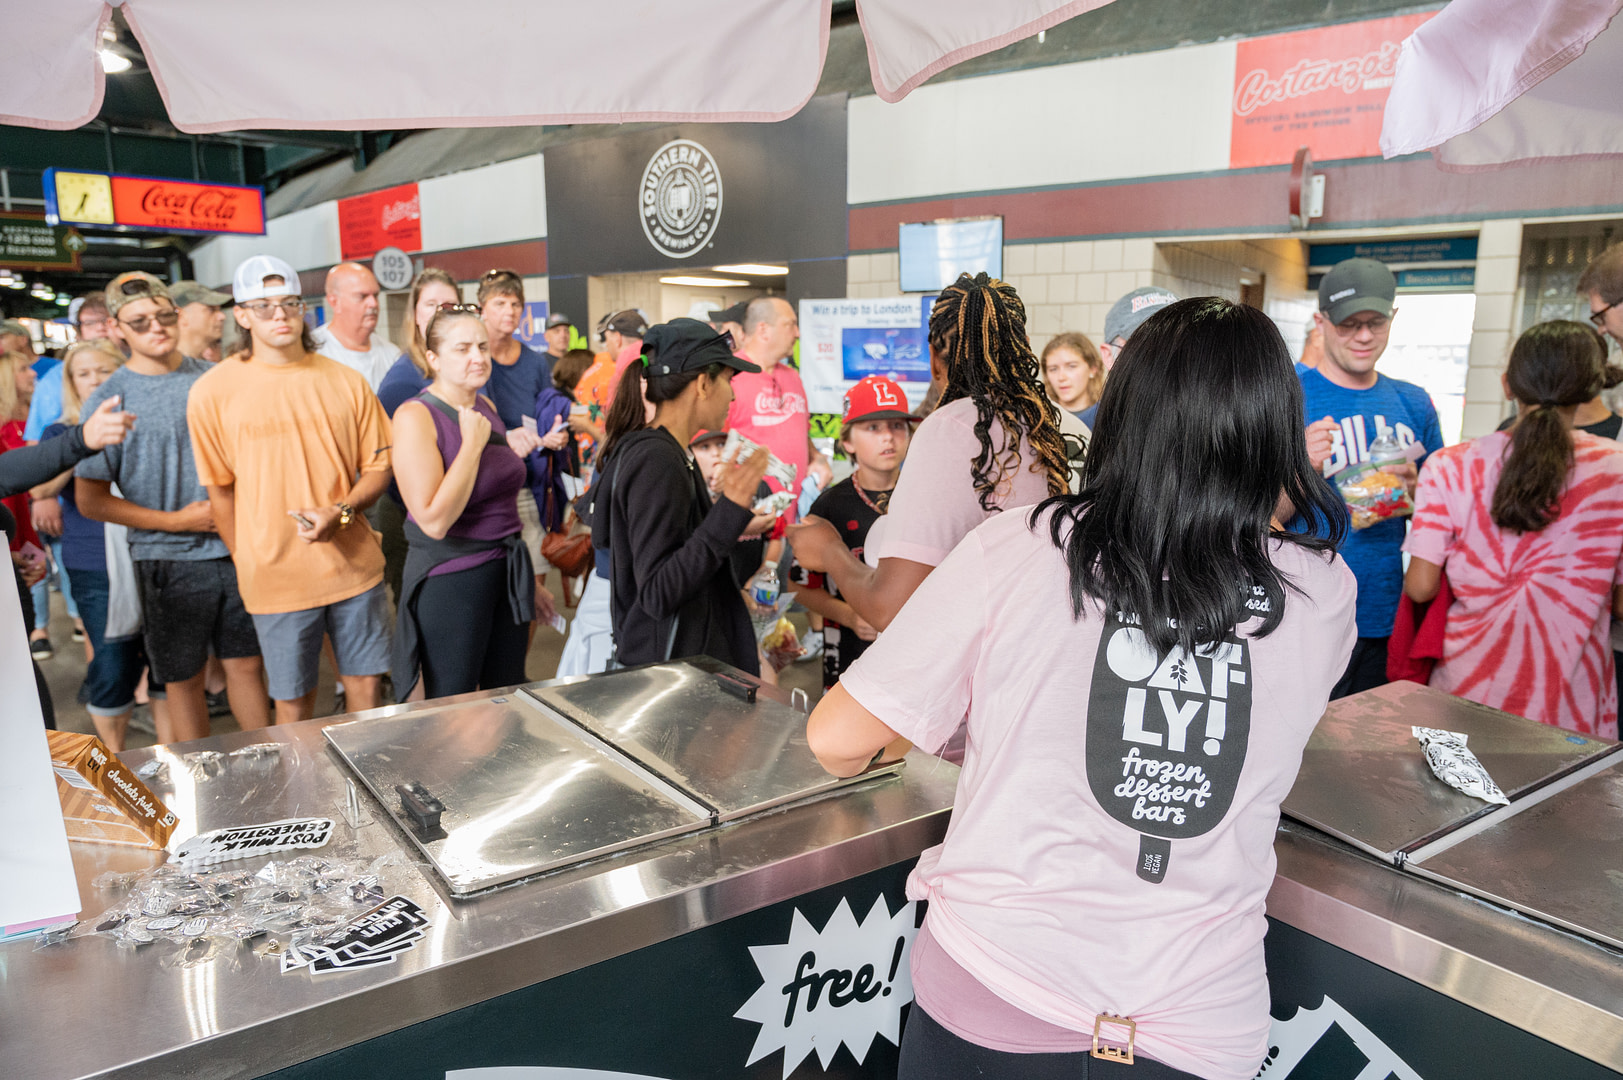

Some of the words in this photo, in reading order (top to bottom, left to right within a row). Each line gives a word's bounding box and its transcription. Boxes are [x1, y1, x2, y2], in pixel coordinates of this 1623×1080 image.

[644, 146, 702, 217] SOUTHERN
[700, 162, 719, 211] TIER
[382, 255, 405, 270] 105
[382, 270, 405, 283] 107
[811, 304, 830, 315] Win
[832, 307, 838, 315] a
[840, 304, 859, 317] trip
[861, 304, 871, 315] to
[874, 304, 912, 315] London
[873, 382, 898, 406] L
[1122, 688, 1226, 756] LY!
[1122, 747, 1206, 783] frozen
[107, 769, 138, 801] chocolate
[136, 796, 157, 818] fudge
[1114, 775, 1212, 808] dessert
[1132, 796, 1186, 825] bars
[210, 821, 331, 844] GENERATION
[276, 831, 328, 845] POST
[219, 837, 276, 852] MILK
[1143, 853, 1154, 871] 100%
[1151, 854, 1163, 875] VEGAN
[380, 900, 408, 915] on
[360, 915, 403, 938] run
[782, 935, 906, 1029] free!
